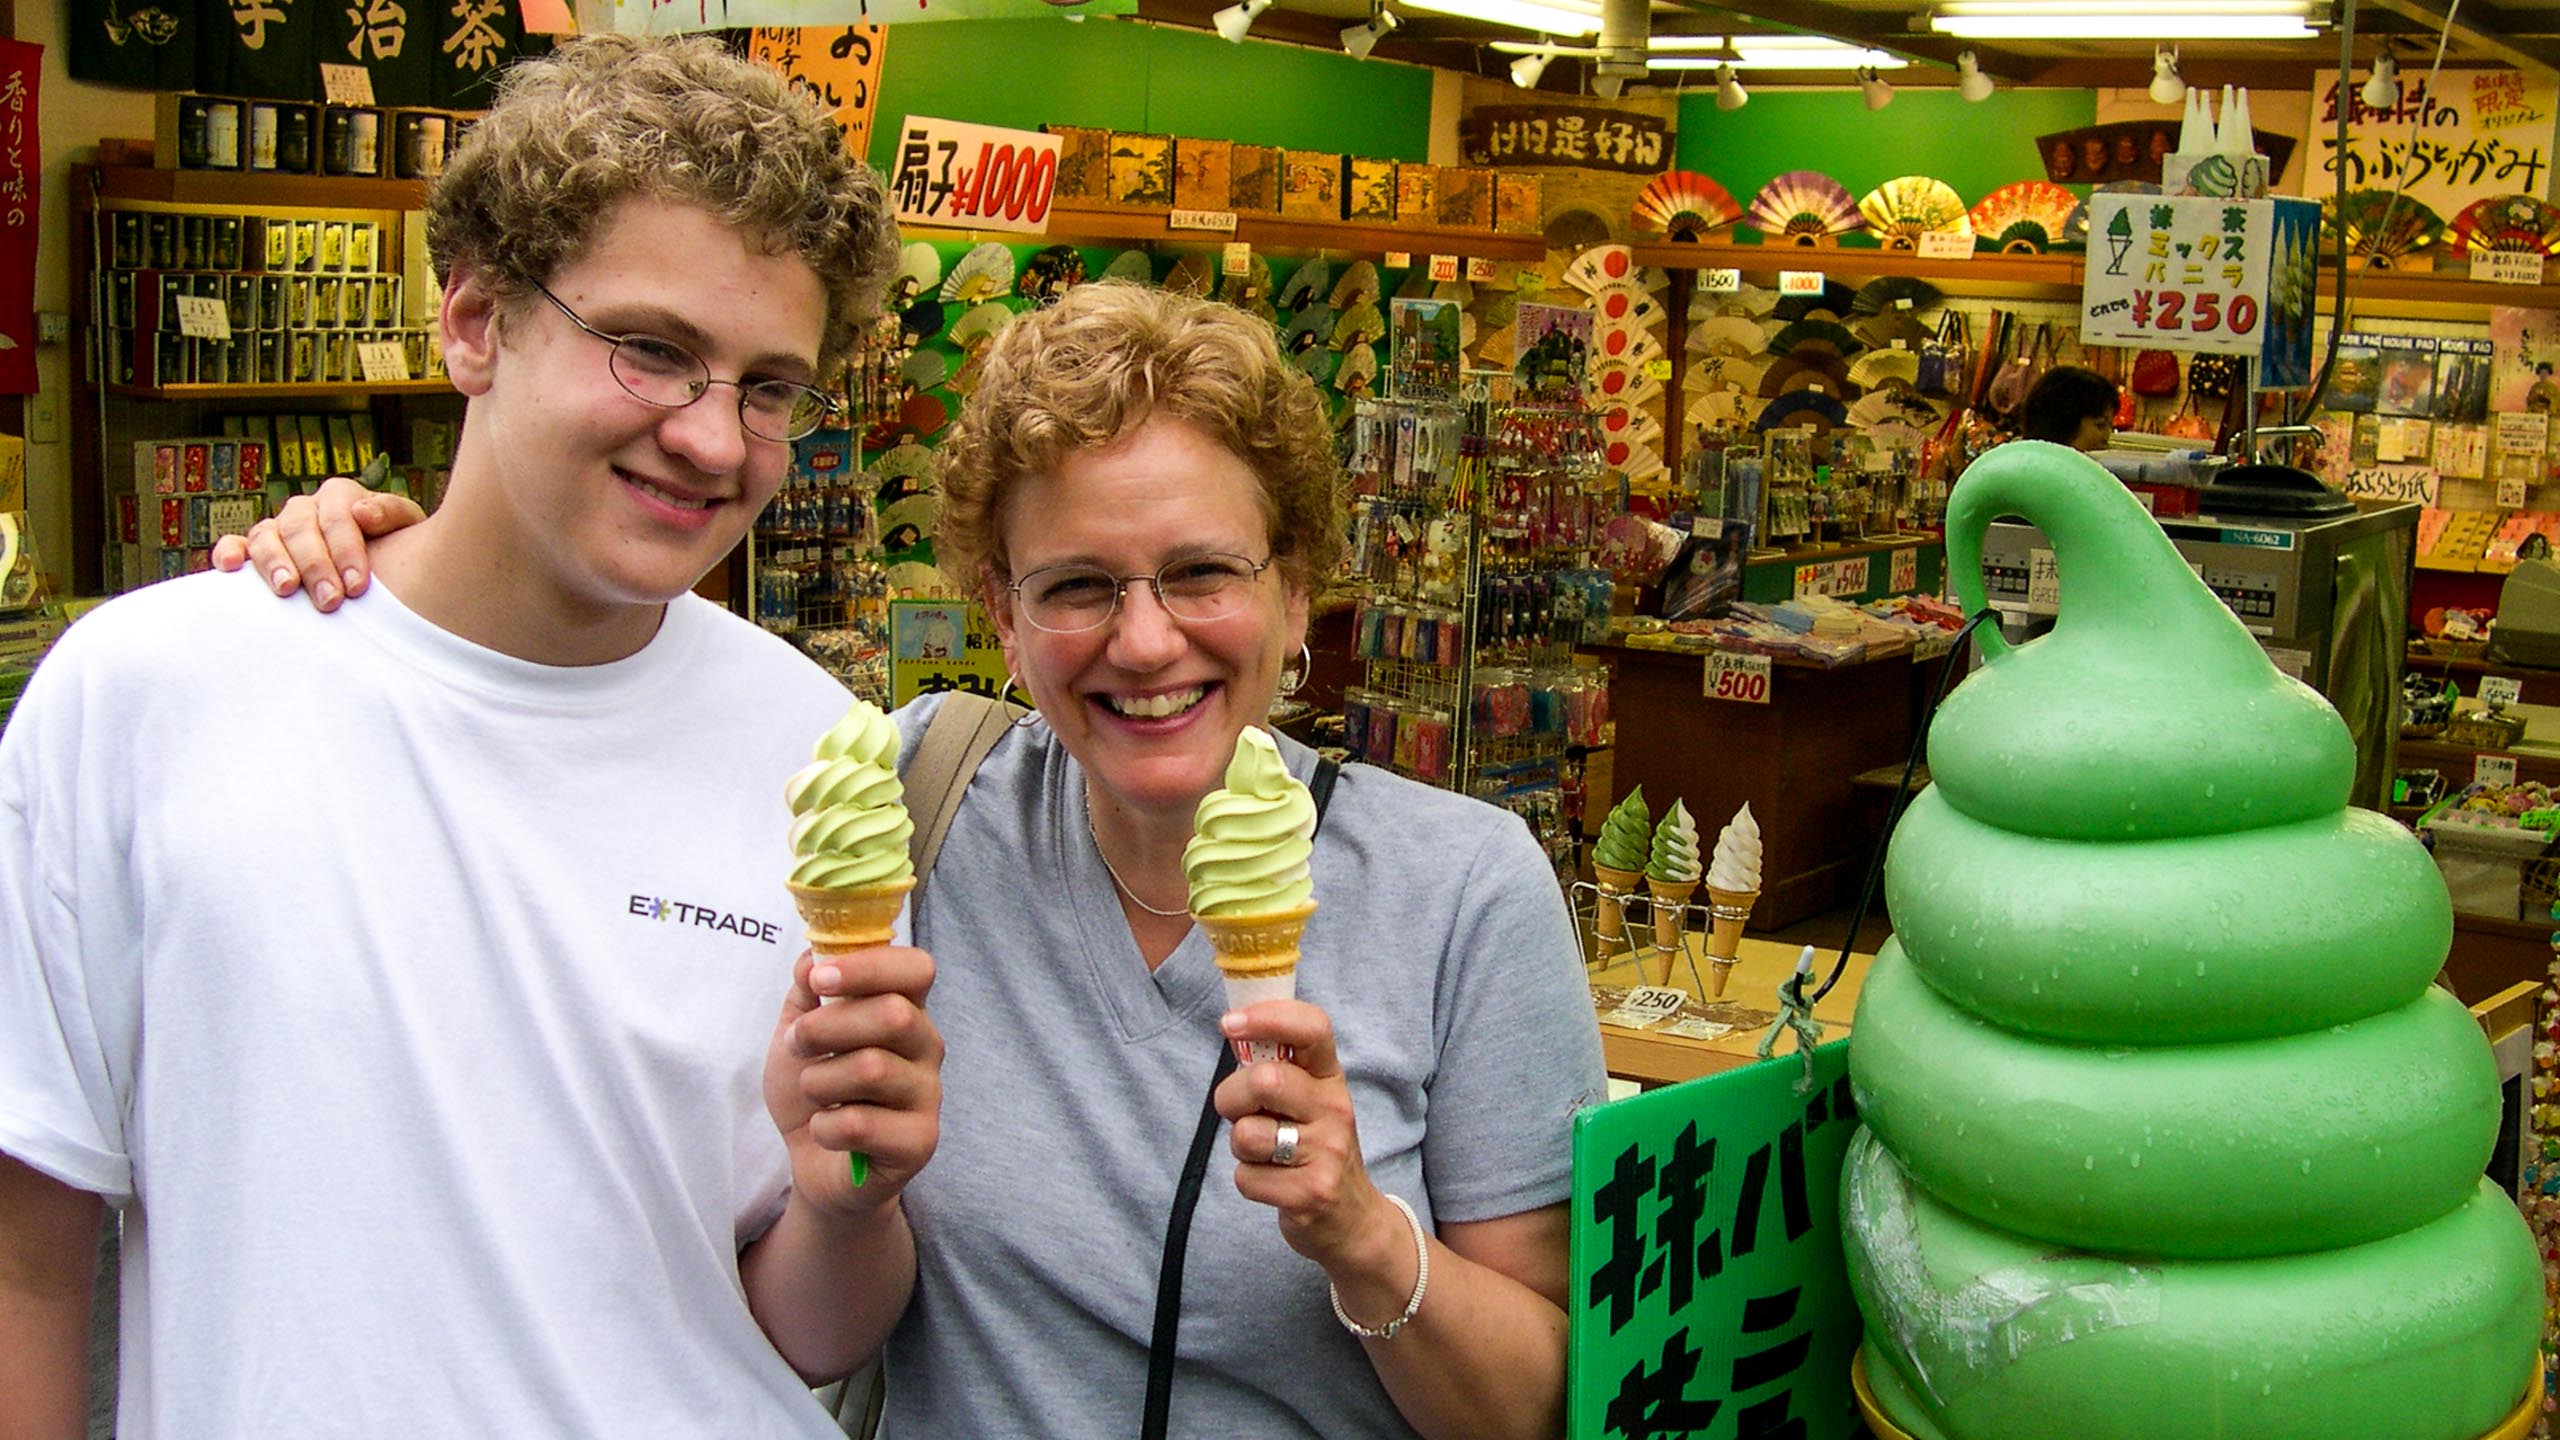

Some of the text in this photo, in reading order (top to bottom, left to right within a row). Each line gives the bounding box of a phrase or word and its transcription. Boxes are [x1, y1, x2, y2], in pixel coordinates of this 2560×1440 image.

[1, 70, 28, 226] 香りと味の
[893, 129, 1057, 224] 扇子 ¥1000
[2147, 231, 2247, 262] ミックス
[2131, 288, 2259, 335] ¥250
[1709, 670, 1766, 701] ¥500
